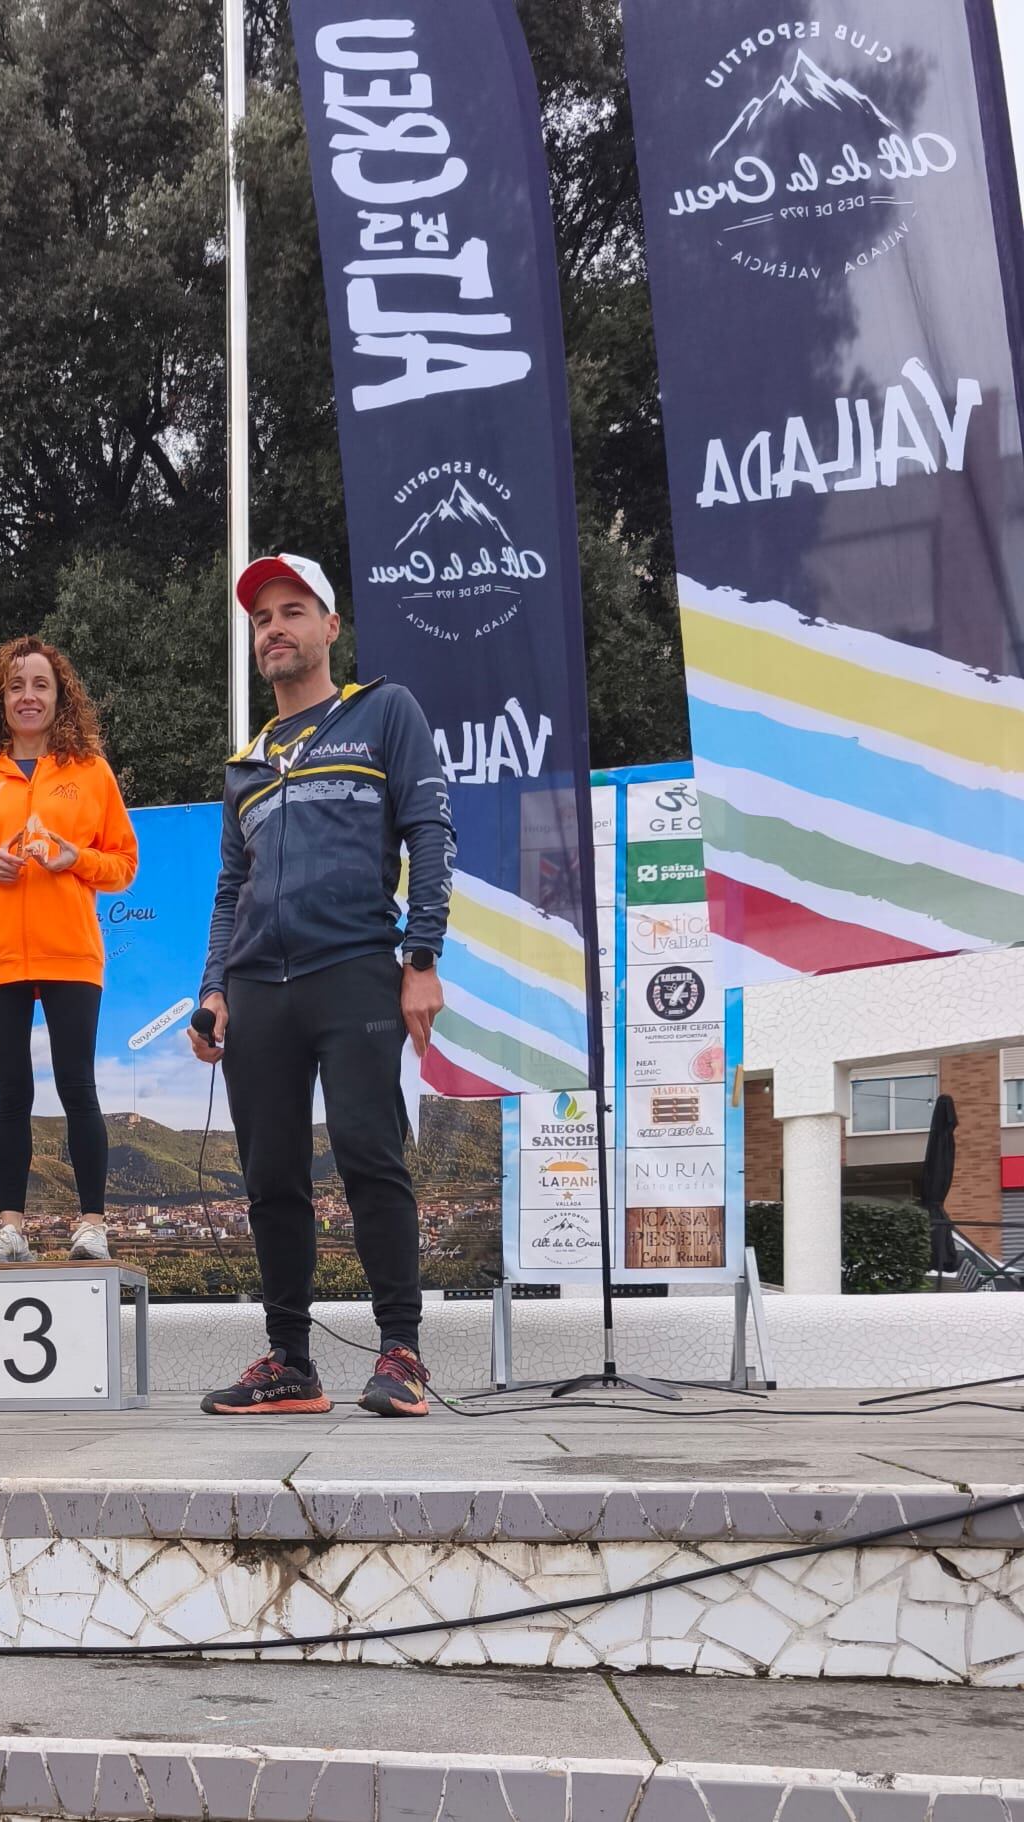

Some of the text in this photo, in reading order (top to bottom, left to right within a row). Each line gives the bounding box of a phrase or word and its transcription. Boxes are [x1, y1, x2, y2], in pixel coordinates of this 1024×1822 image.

[660, 863, 694, 872] caixa
[109, 901, 157, 923] Creu
[652, 1087, 699, 1095] MADERAS
[541, 1124, 595, 1134] RIEGOS
[637, 1129, 666, 1137] CAMP
[636, 1162, 715, 1178] NURIA
[645, 1212, 709, 1227] CASA
[553, 1238, 563, 1247] de
[564, 1238, 573, 1247] la
[576, 1238, 602, 1248] Creu
[628, 1231, 722, 1247] PESETA
[642, 1251, 712, 1263] Casa Rural
[3, 1297, 58, 1384] 3
